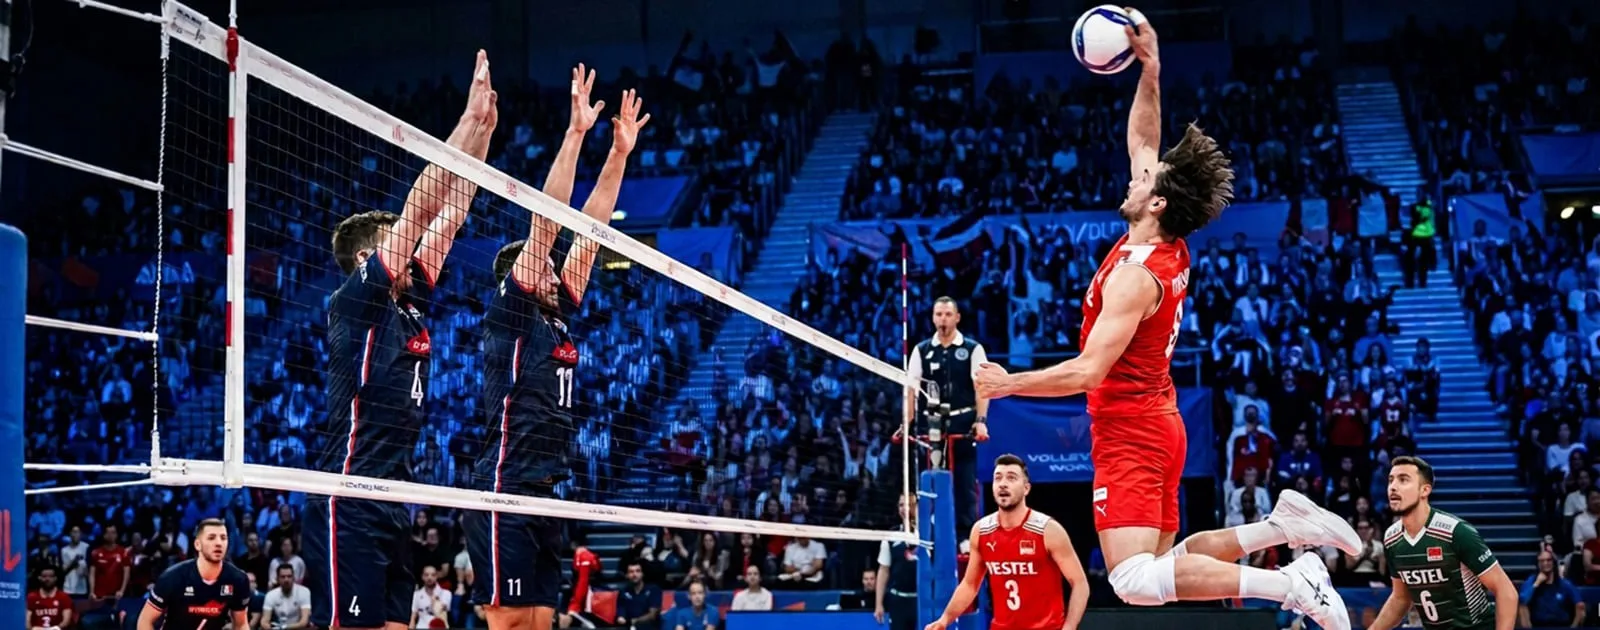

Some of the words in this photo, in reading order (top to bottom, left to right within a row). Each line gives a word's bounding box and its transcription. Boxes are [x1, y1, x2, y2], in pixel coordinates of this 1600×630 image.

[410, 360, 424, 407] 4
[507, 578, 521, 596] 11
[1005, 579, 1021, 611] 3
[348, 595, 361, 617] 4
[1420, 590, 1439, 622] 6
